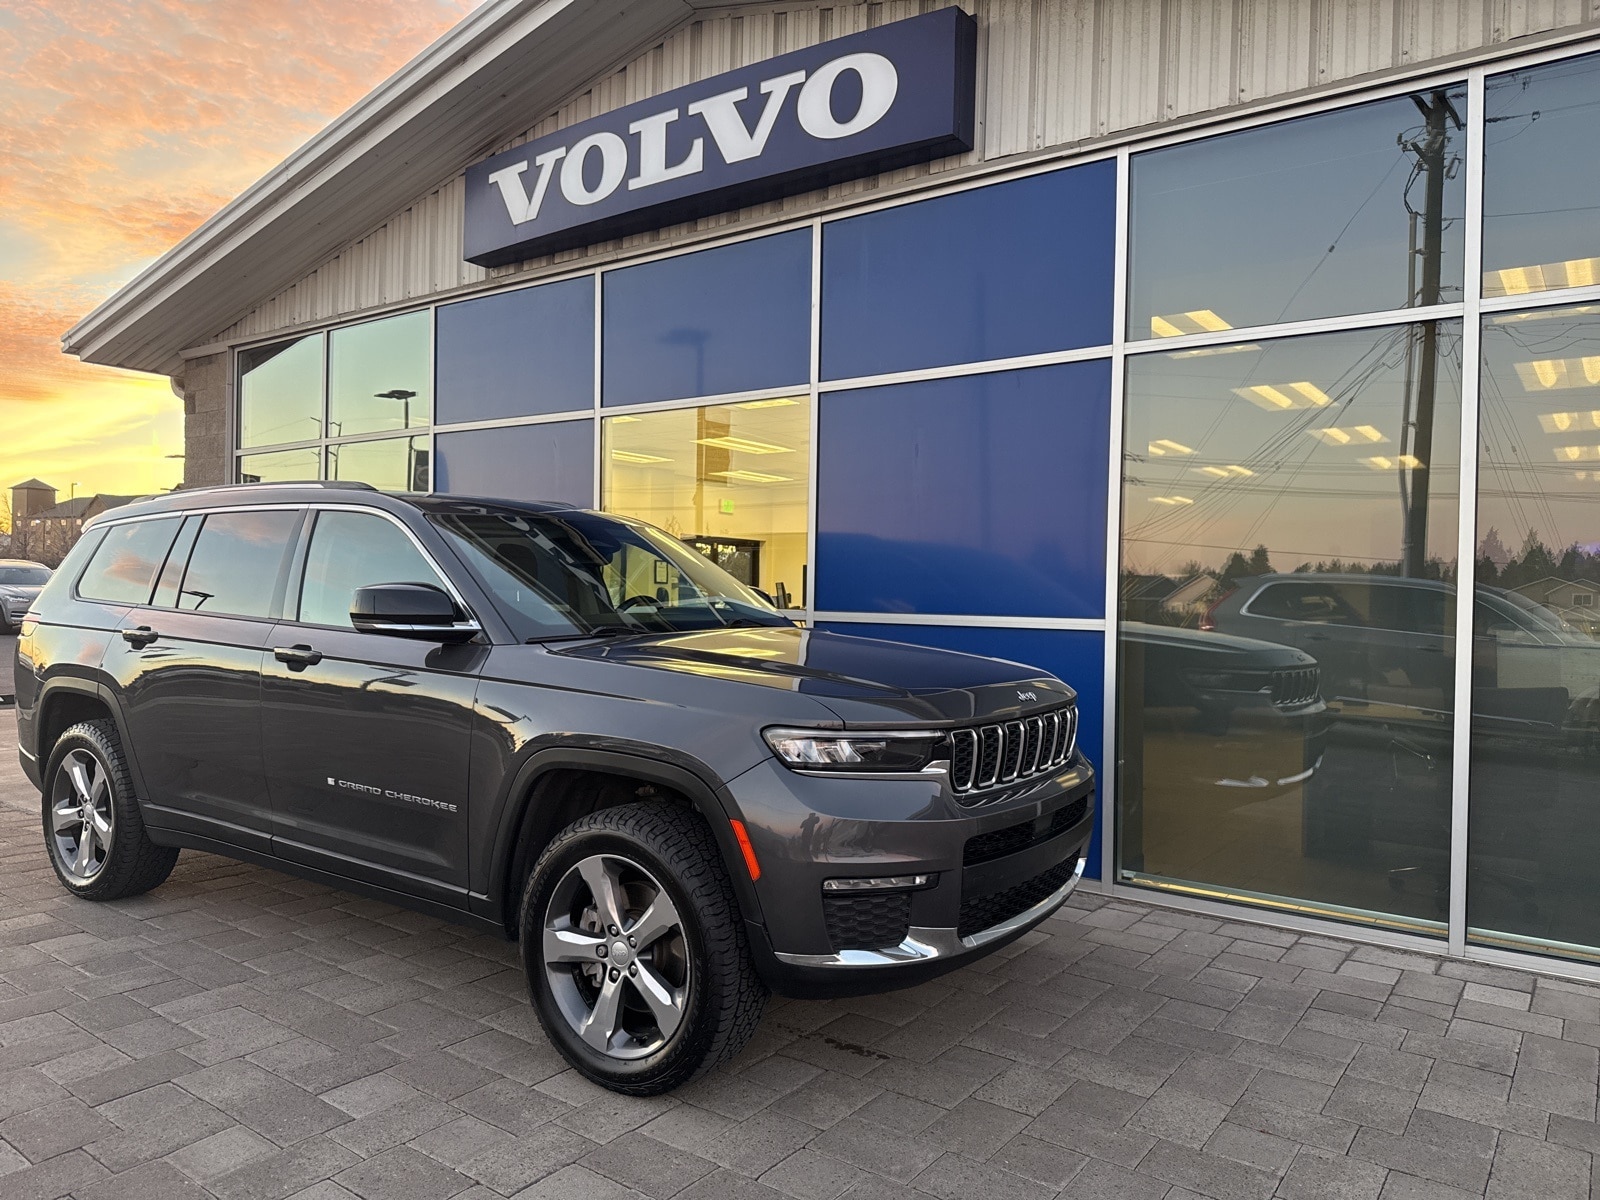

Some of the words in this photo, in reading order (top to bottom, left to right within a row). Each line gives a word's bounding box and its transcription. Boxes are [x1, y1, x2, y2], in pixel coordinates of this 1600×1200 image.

[489, 52, 898, 226] VOLVO
[1017, 690, 1037, 702] Jeep
[338, 780, 382, 795] GRAND
[385, 790, 458, 812] CHEROKEE
